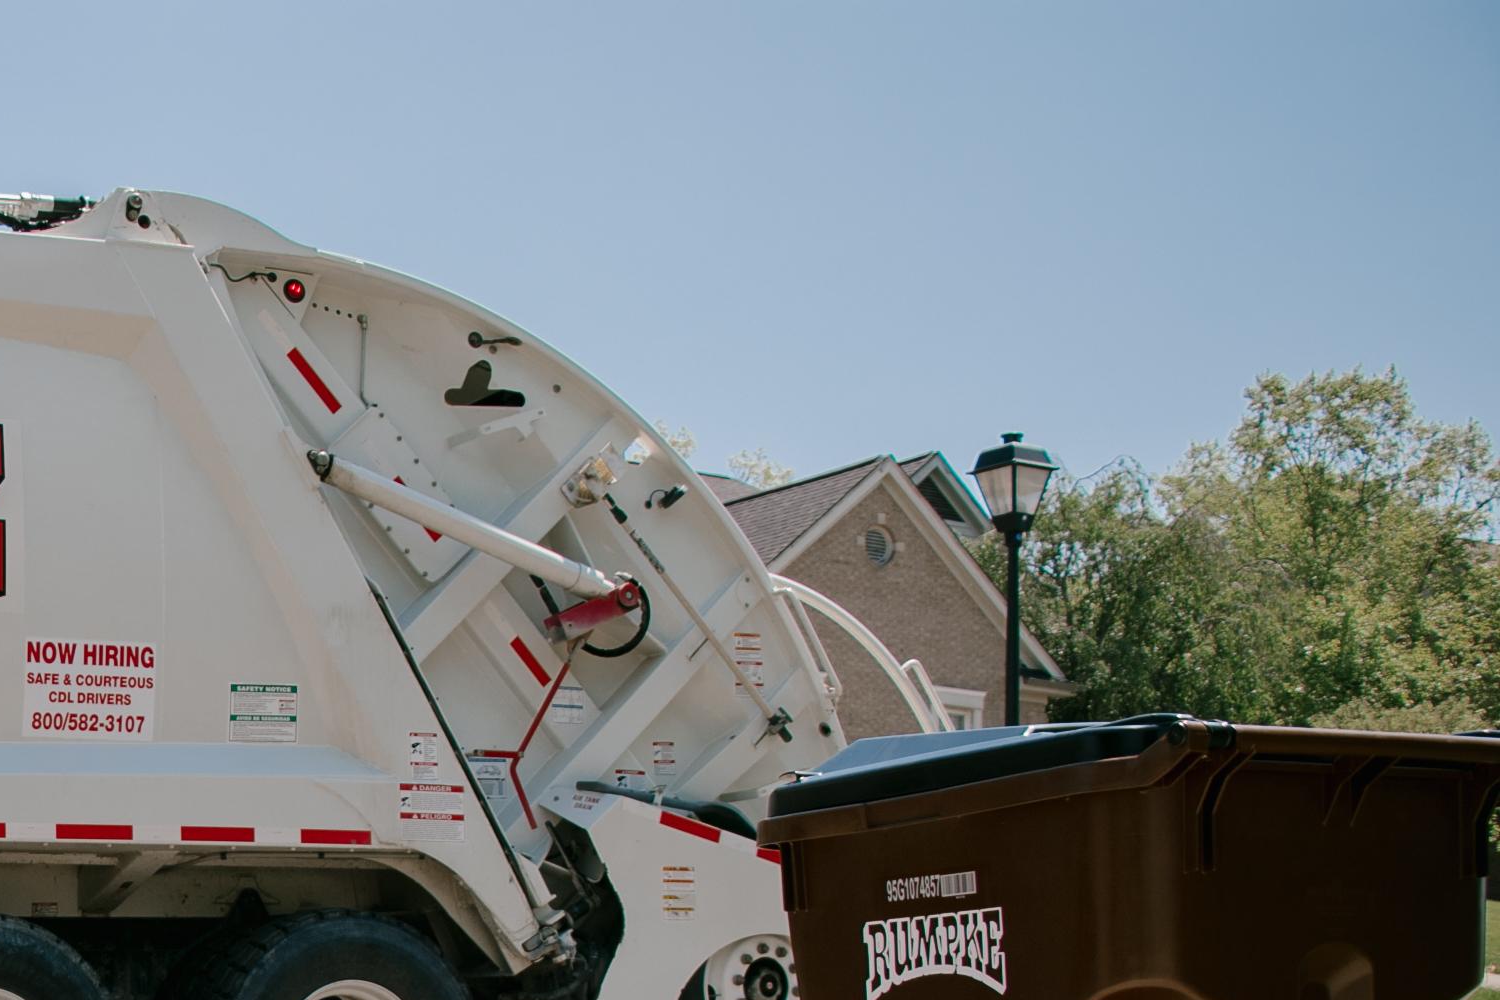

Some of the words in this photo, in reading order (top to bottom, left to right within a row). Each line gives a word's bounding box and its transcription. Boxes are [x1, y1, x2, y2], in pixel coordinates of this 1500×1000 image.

[27, 641, 77, 664] NOW
[83, 644, 154, 668] HIRING
[26, 672, 60, 685] SAFE
[63, 673, 72, 686] &
[75, 674, 154, 689] COURTEOUS
[48, 691, 74, 704] CDL
[77, 692, 132, 706] DRIVERS
[31, 711, 146, 734] 800/582-3107
